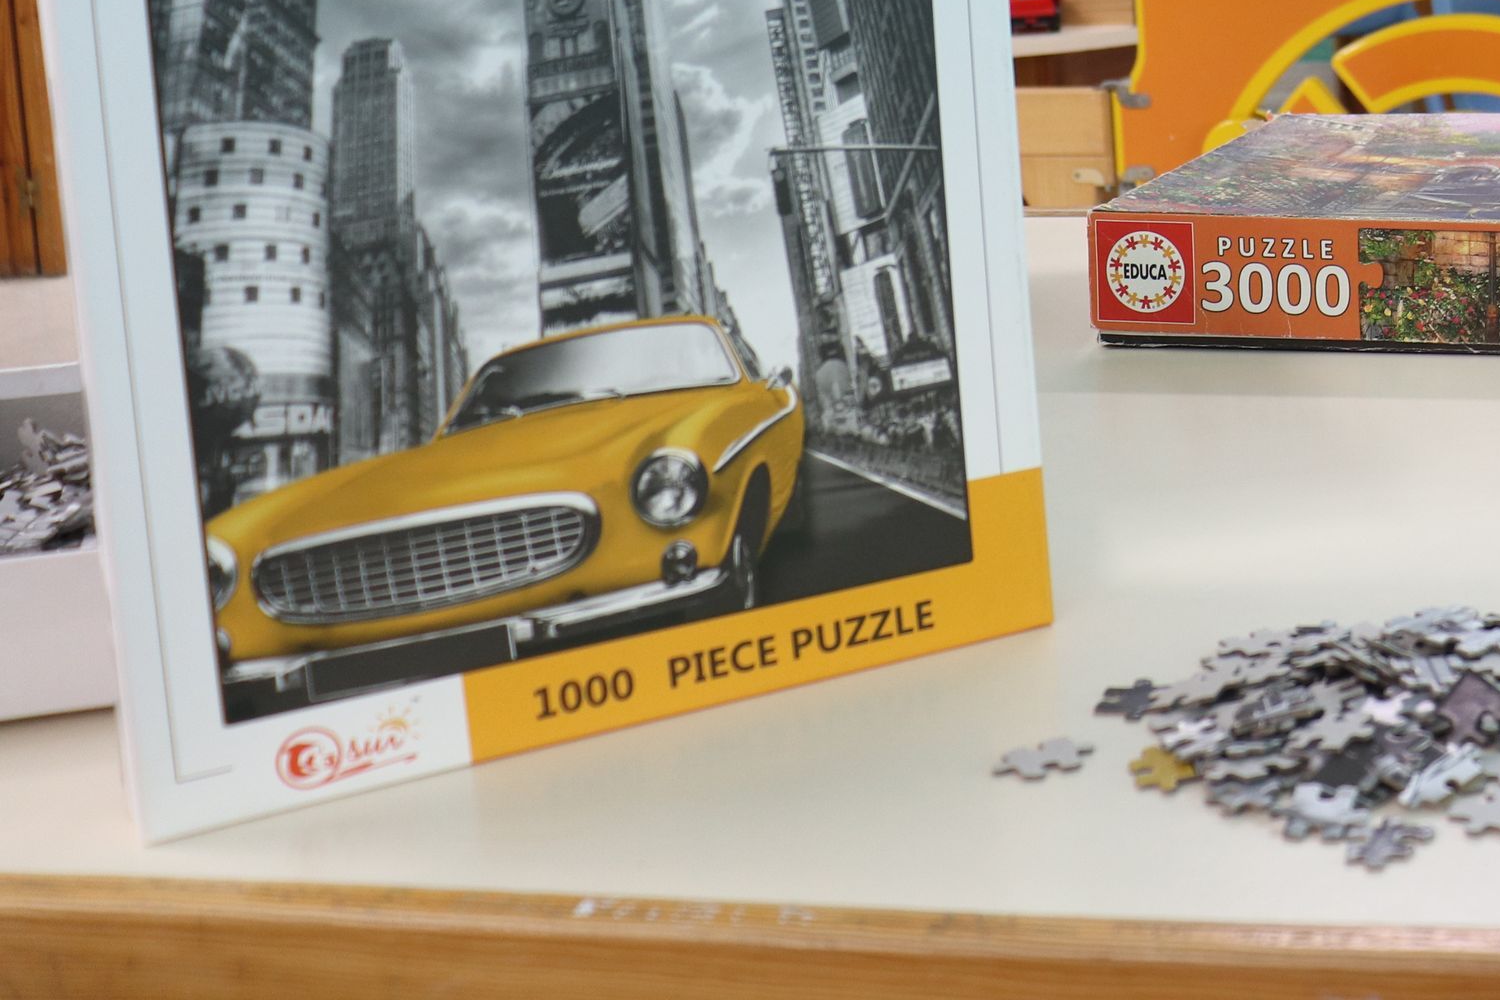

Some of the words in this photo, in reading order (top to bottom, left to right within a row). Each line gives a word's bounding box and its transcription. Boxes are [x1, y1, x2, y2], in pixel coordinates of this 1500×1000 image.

[1217, 236, 1334, 260] PUZZLE
[1123, 263, 1168, 281] EDUCA
[1200, 260, 1351, 317] 3000
[533, 668, 634, 722] 1000
[668, 635, 778, 689] PIECE
[791, 600, 935, 660] PUZZLE
